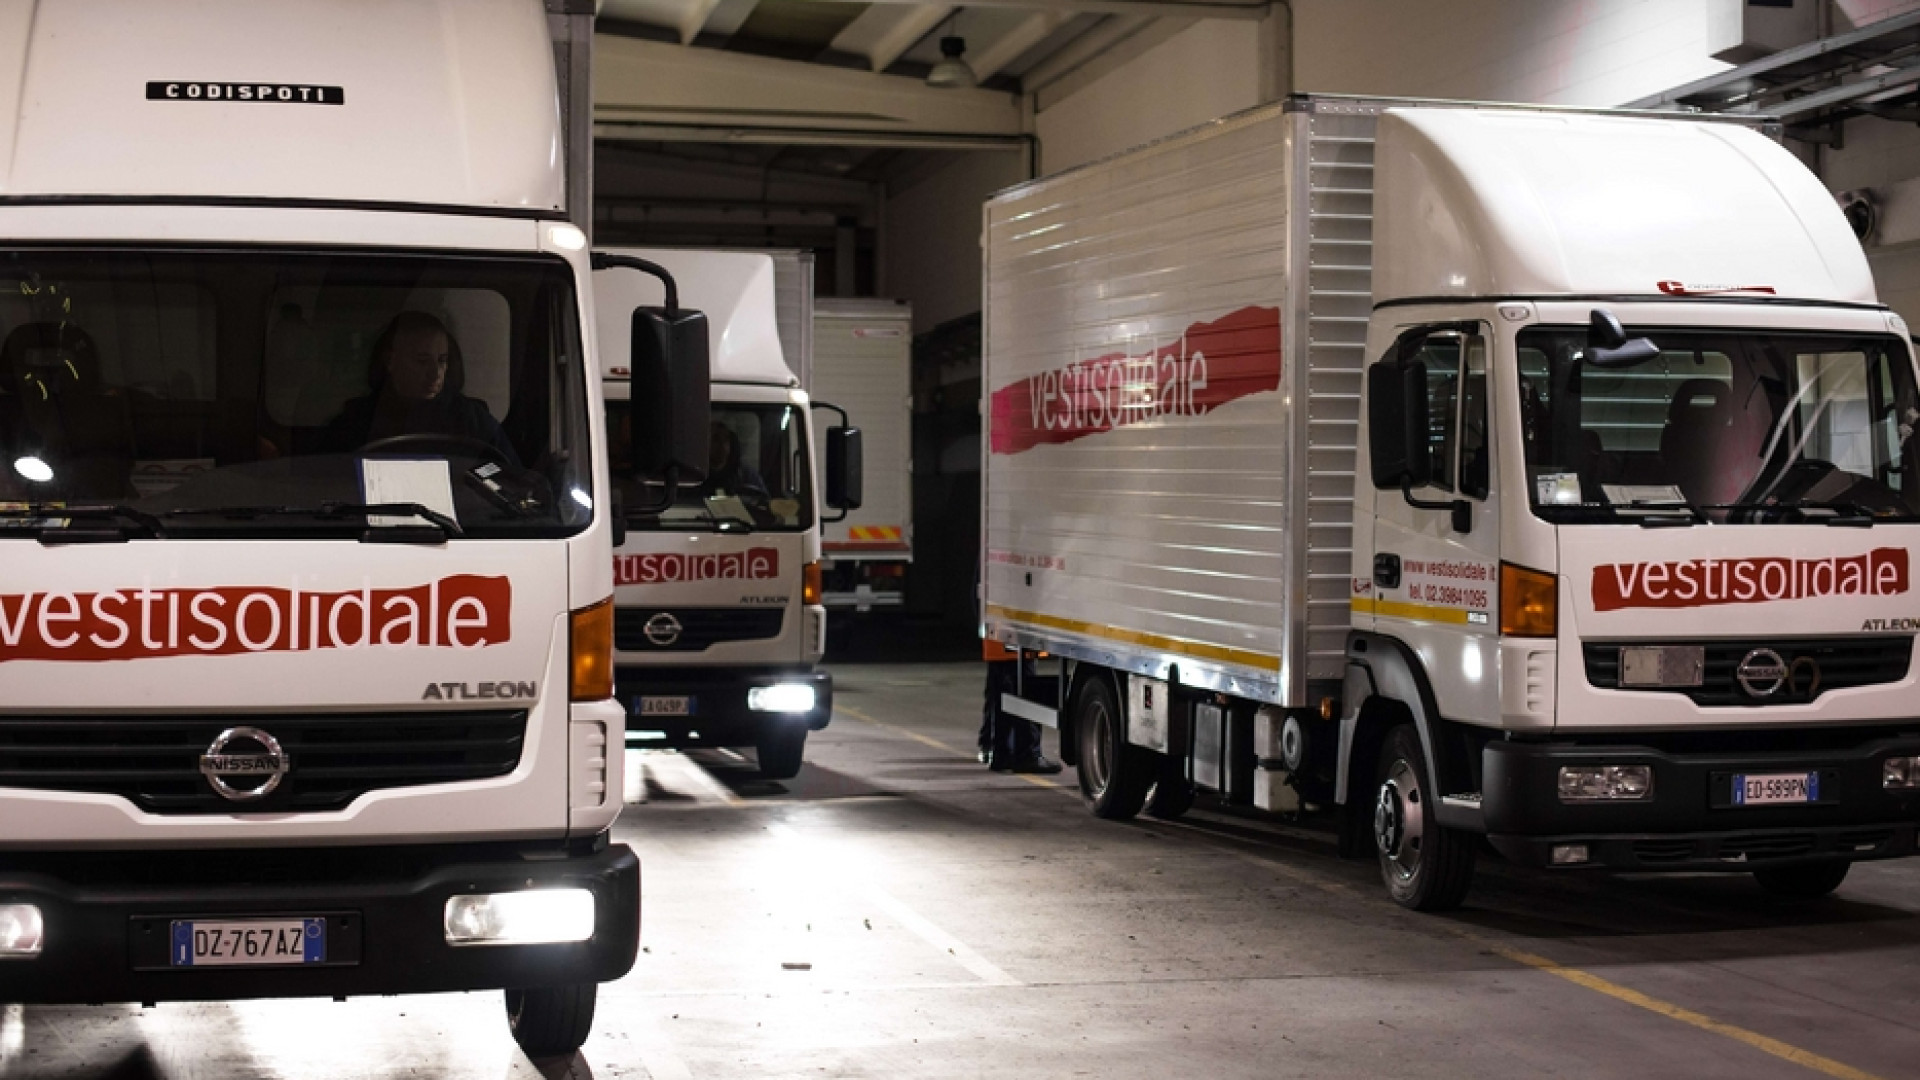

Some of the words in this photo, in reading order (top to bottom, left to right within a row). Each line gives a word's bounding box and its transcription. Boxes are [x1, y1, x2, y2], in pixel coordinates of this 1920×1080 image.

[166, 84, 324, 101] CODISPOTI
[1029, 335, 1208, 429] vestisolidale
[1613, 550, 1898, 599] vestisolidale
[422, 680, 537, 700] ATLEON
[209, 758, 280, 771] NISSAN
[195, 928, 303, 957] DZ-767AZ
